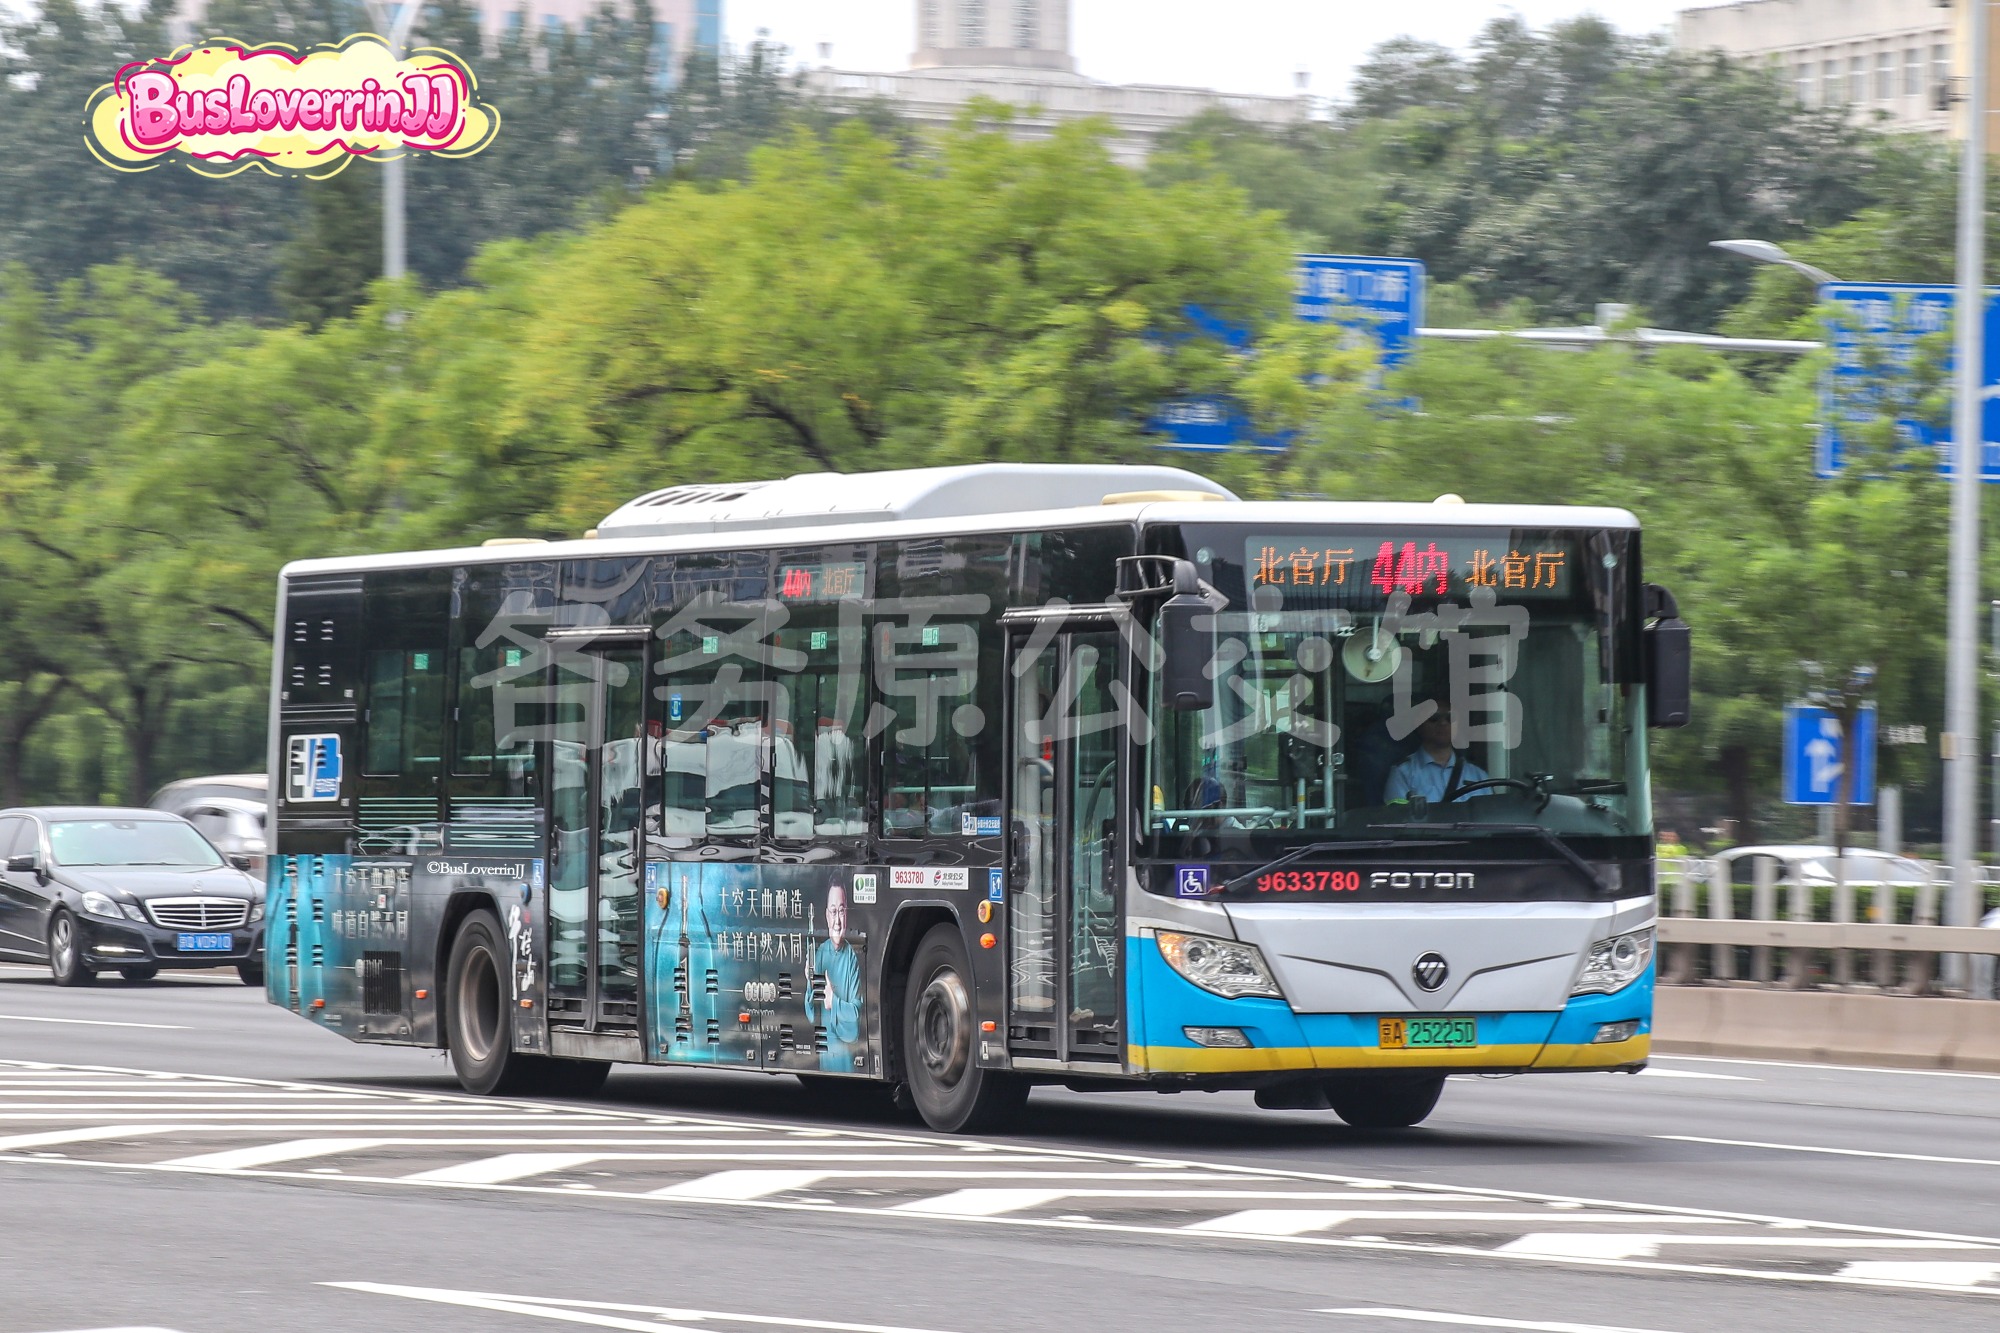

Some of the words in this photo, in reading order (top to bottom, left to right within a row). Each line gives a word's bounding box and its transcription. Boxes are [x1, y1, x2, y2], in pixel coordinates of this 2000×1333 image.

[1253, 546, 1354, 586] 北官厅
[1370, 541, 1448, 594] 44内
[1465, 549, 1566, 589] 北官厅
[895, 871, 924, 884] 9633780
[1257, 871, 1360, 892] 9633780
[1370, 872, 1475, 889] FOTON
[718, 887, 803, 919] 太空天曲酿造
[717, 930, 802, 964] 味道自然不同
